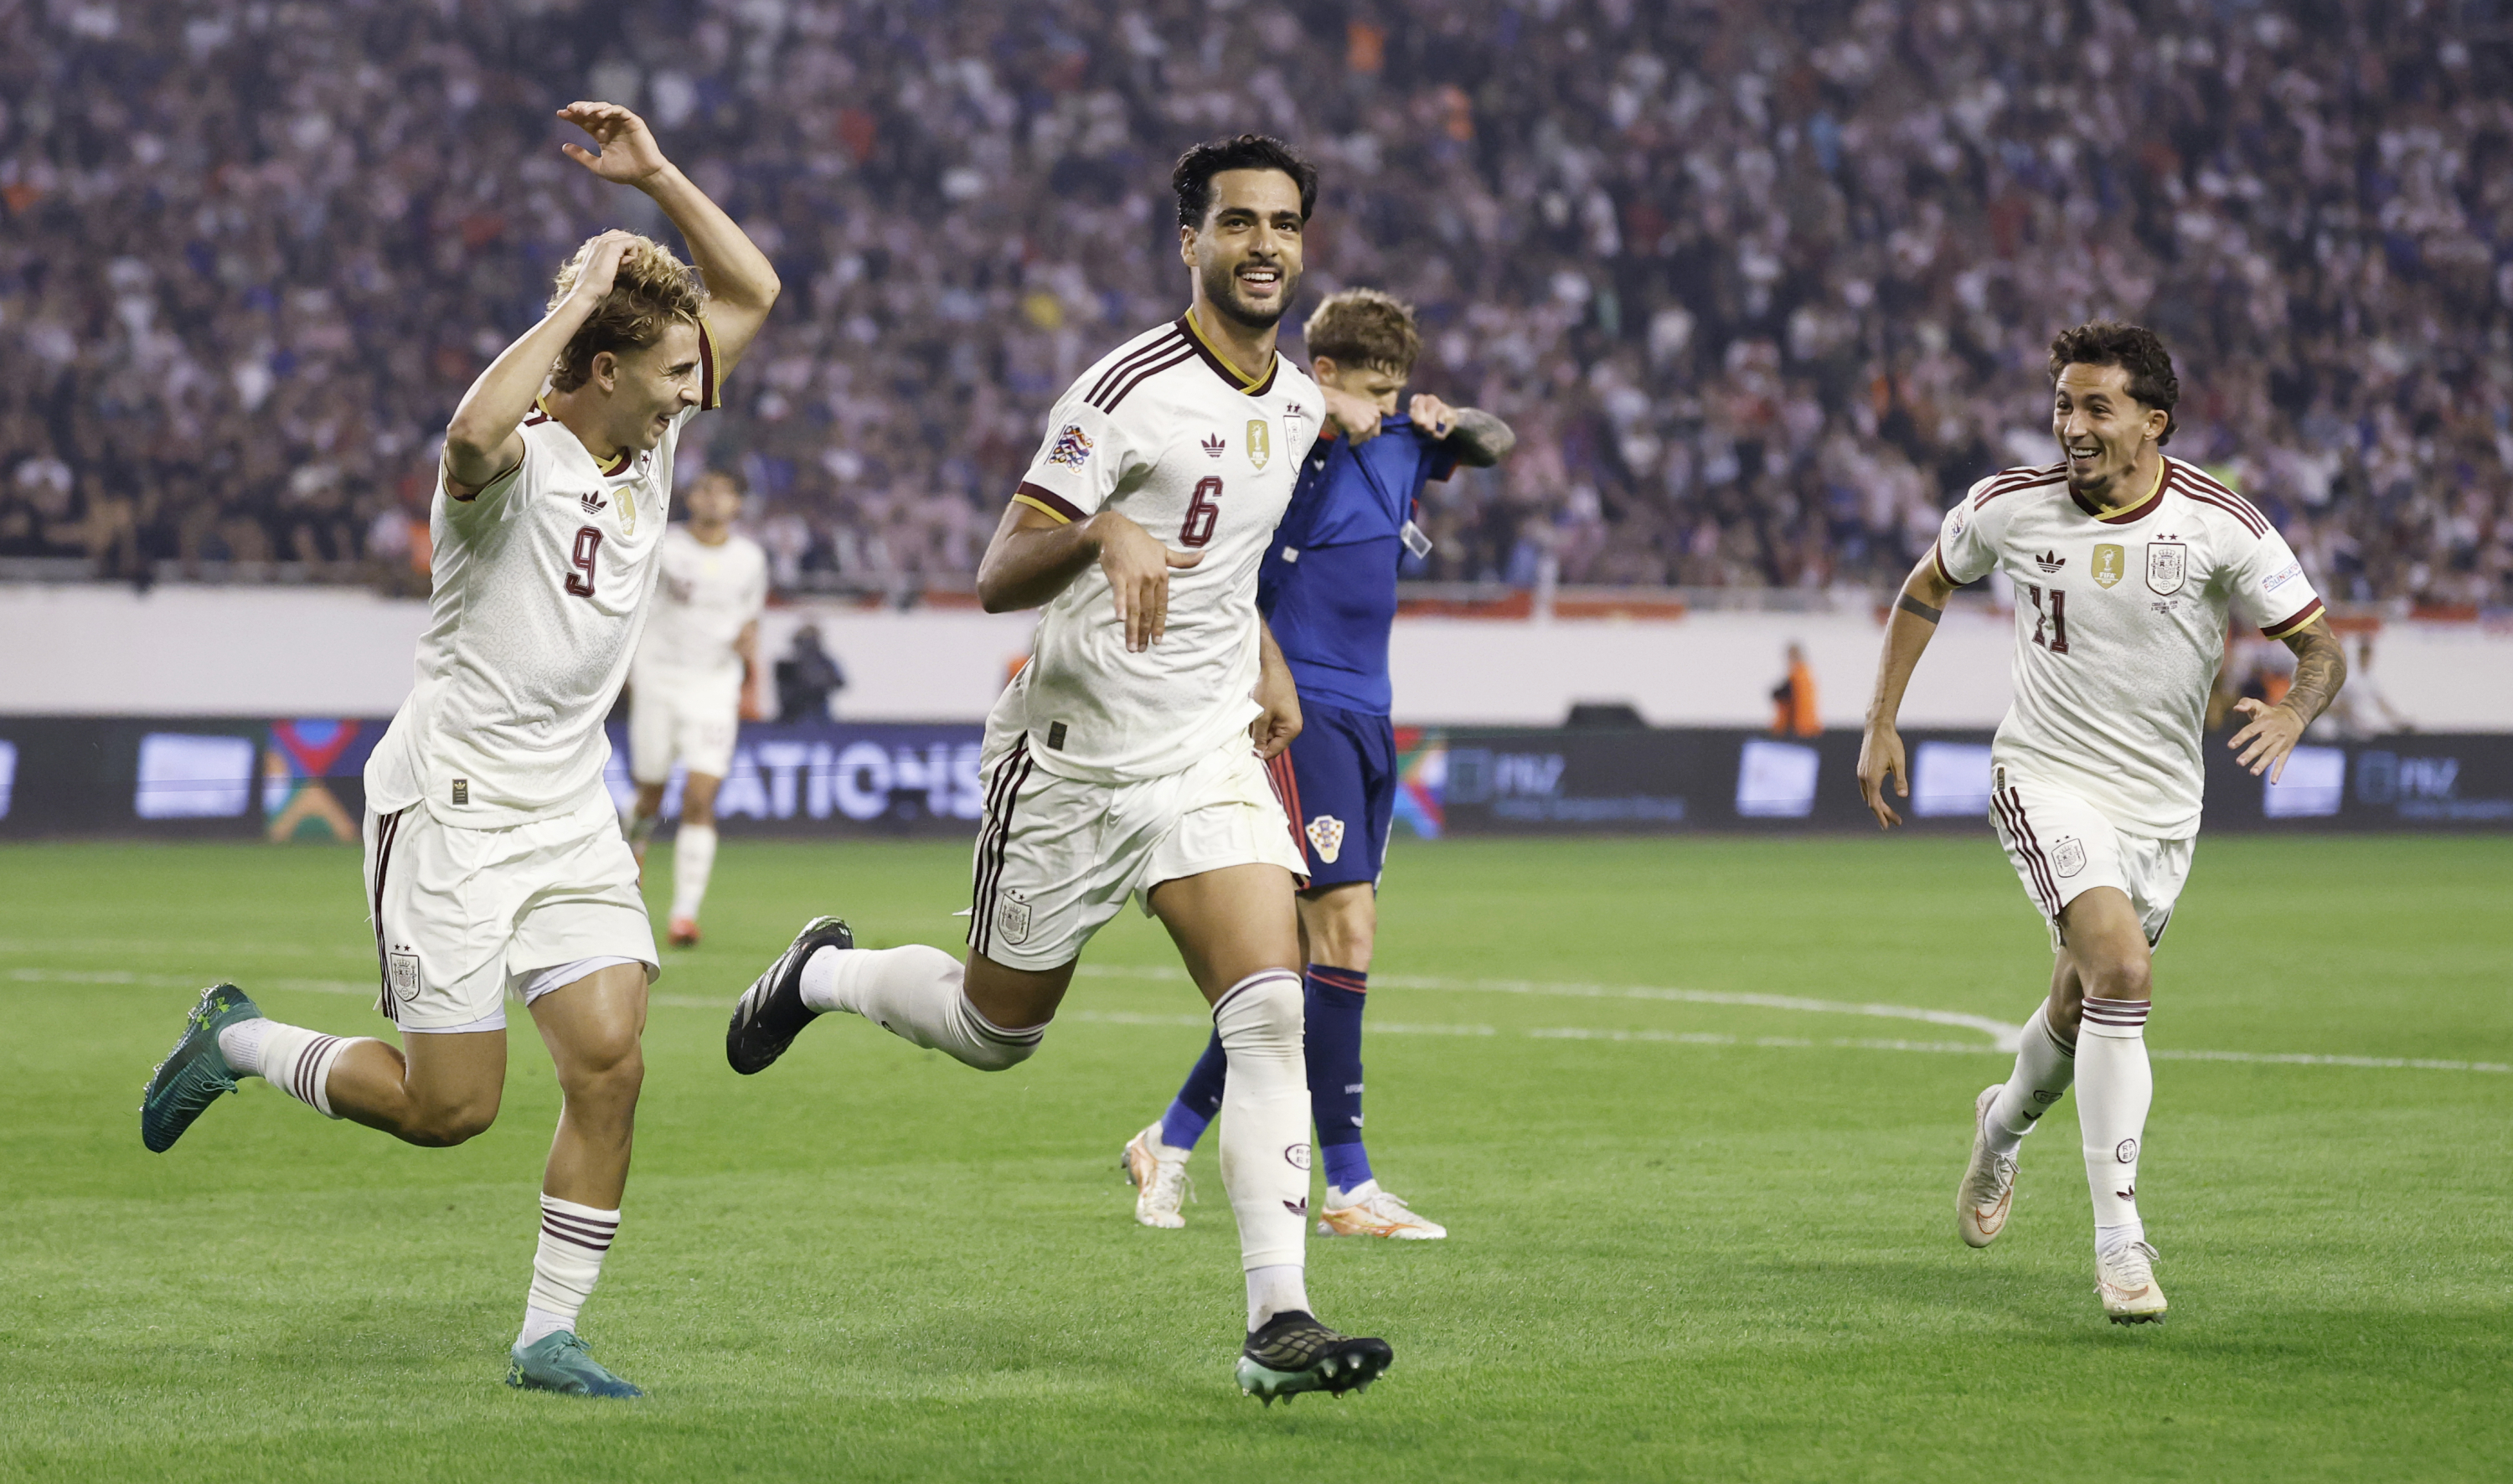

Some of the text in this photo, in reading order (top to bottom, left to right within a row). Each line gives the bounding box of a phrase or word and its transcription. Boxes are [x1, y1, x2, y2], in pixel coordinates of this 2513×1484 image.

[1179, 476, 1224, 548] 6
[564, 525, 604, 598] 9
[2029, 585, 2069, 655] 11
